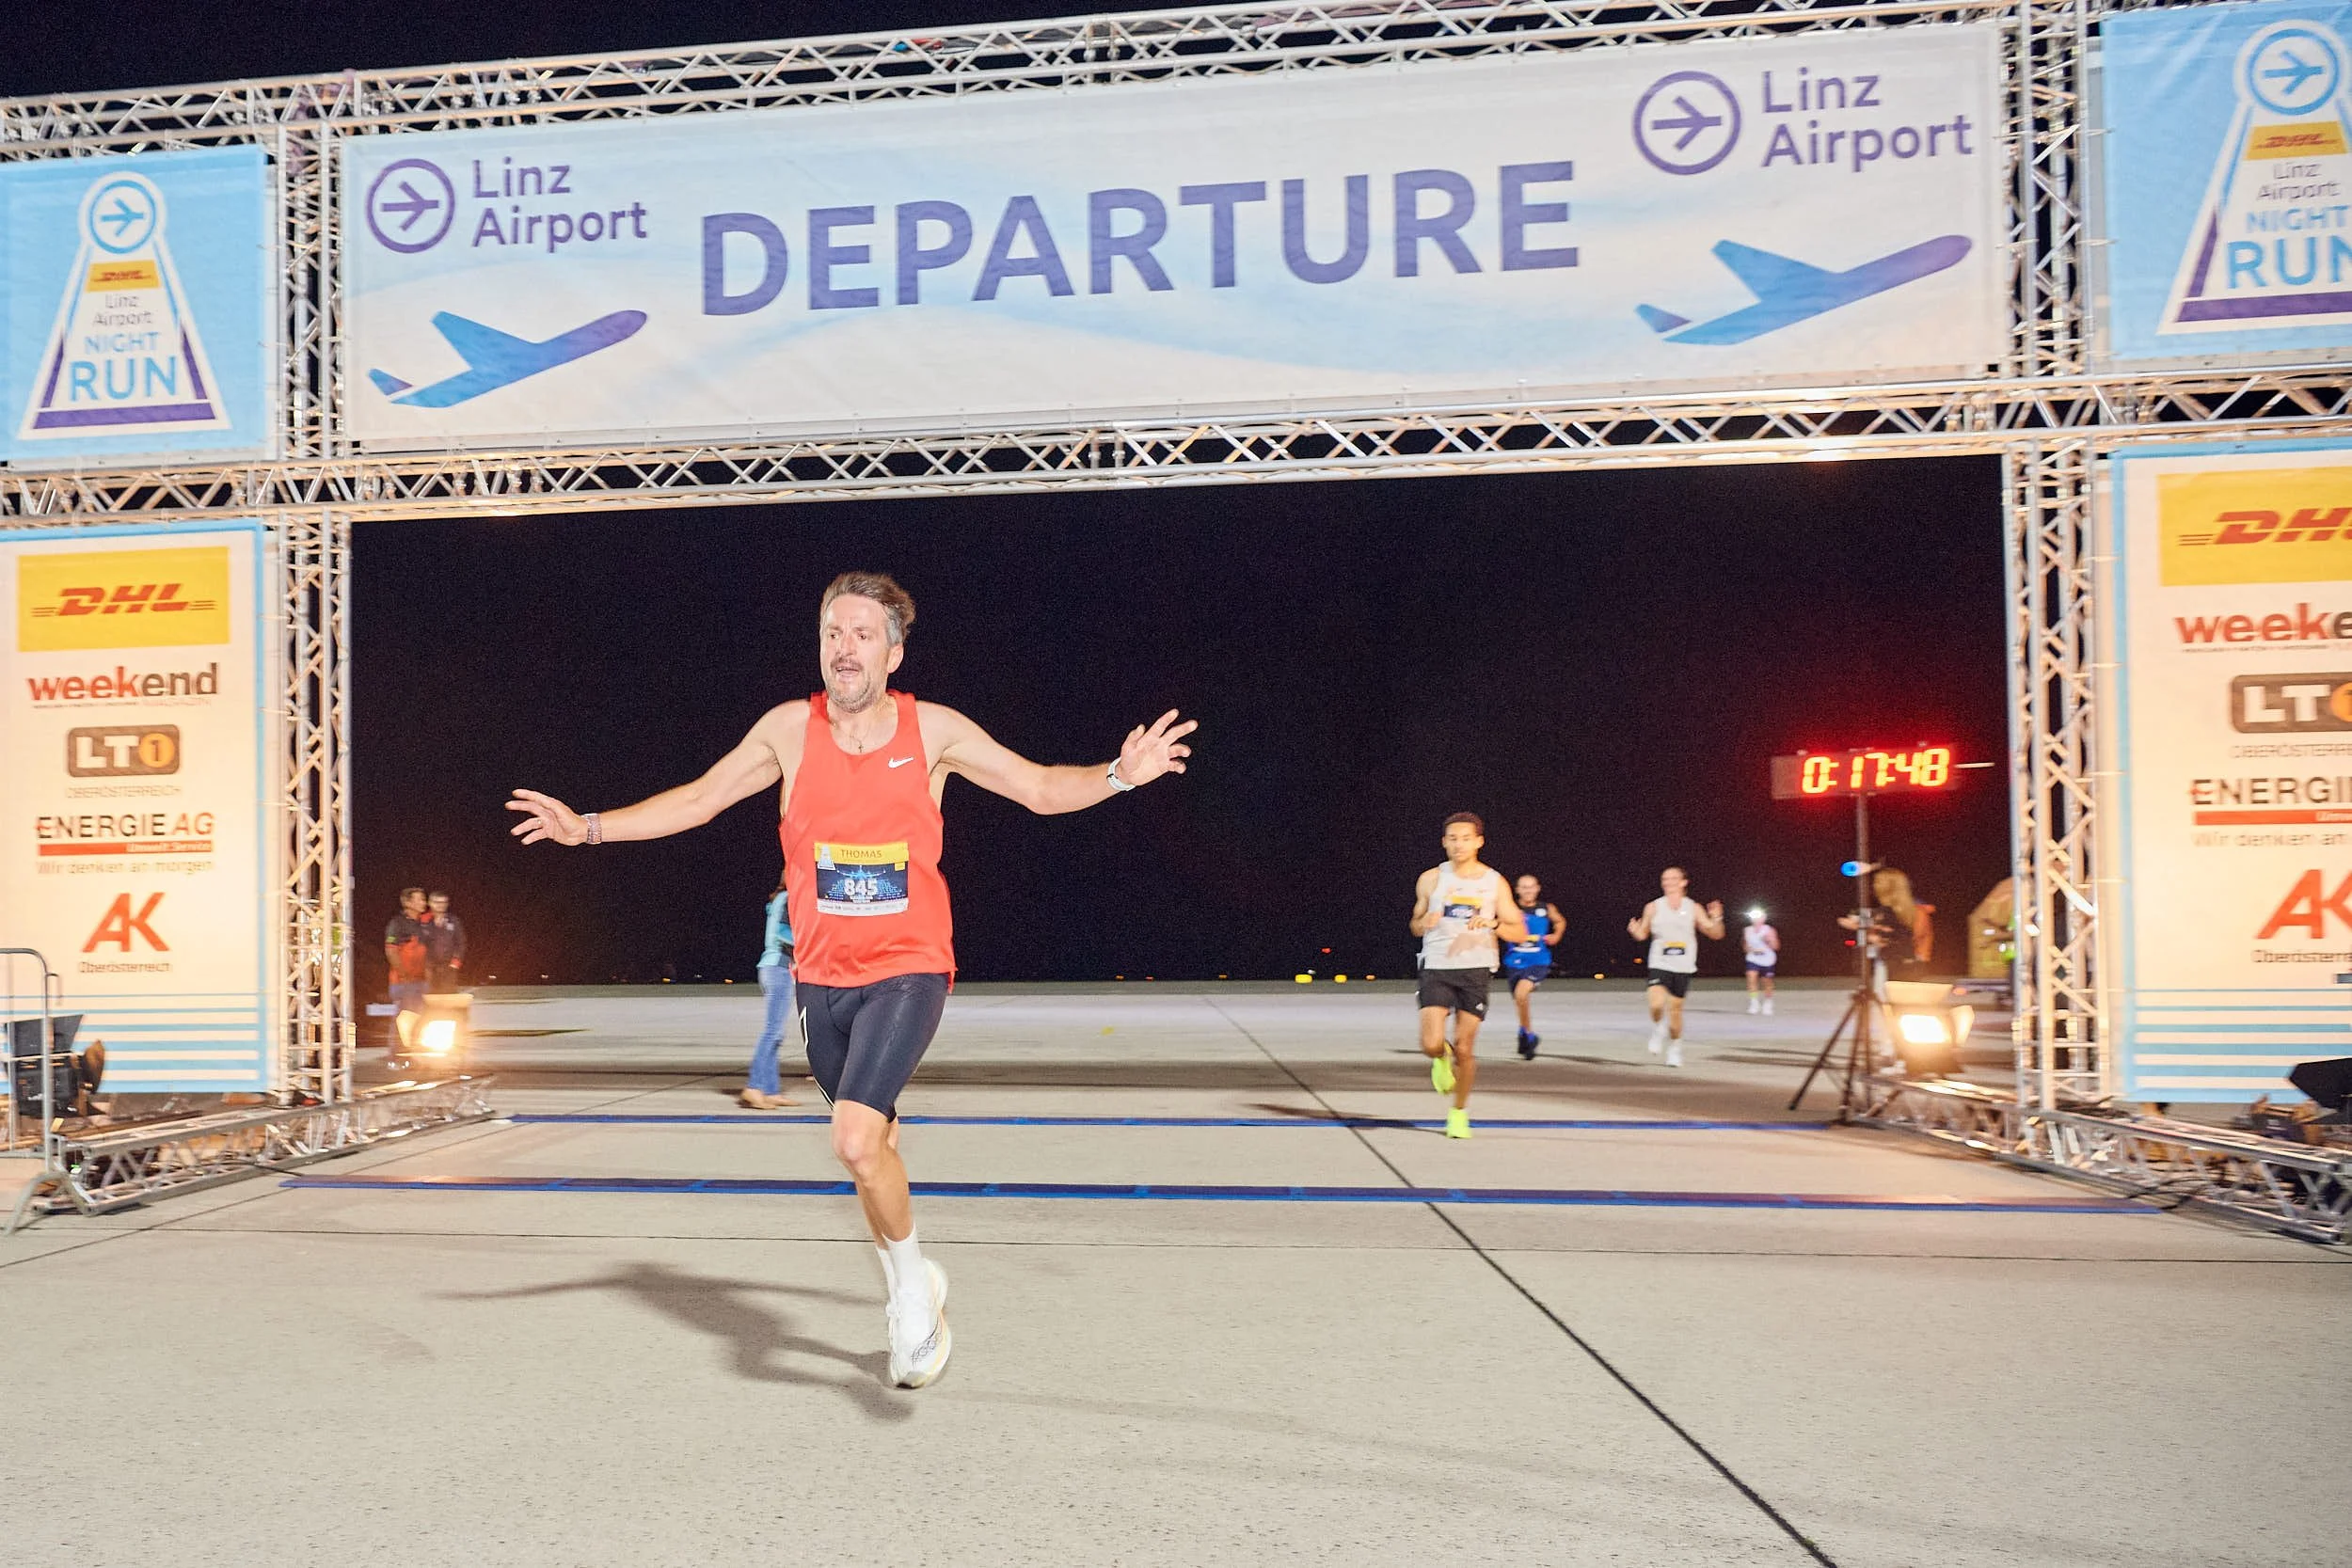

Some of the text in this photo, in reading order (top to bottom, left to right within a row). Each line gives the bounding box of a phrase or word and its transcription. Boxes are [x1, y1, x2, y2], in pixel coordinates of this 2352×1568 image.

[1762, 67, 1881, 113] Linz
[1762, 114, 1974, 173] Airport
[471, 156, 572, 199] Linz
[2273, 162, 2321, 180] Linz
[2257, 181, 2341, 201] Airport
[471, 200, 648, 254] Airport
[702, 159, 1580, 316] DEPARTURE
[2246, 205, 2349, 233] NIGHT
[104, 293, 139, 309] Linz
[85, 330, 161, 355] NIGHT
[70, 356, 177, 403] RUN
[2213, 506, 2352, 546] DH
[55, 582, 192, 617] DHL
[26, 662, 221, 702] weekend
[2190, 776, 2352, 805] ENERGI
[841, 848, 882, 859] THOMAS
[844, 877, 878, 896] 845
[81, 892, 170, 953] AK
